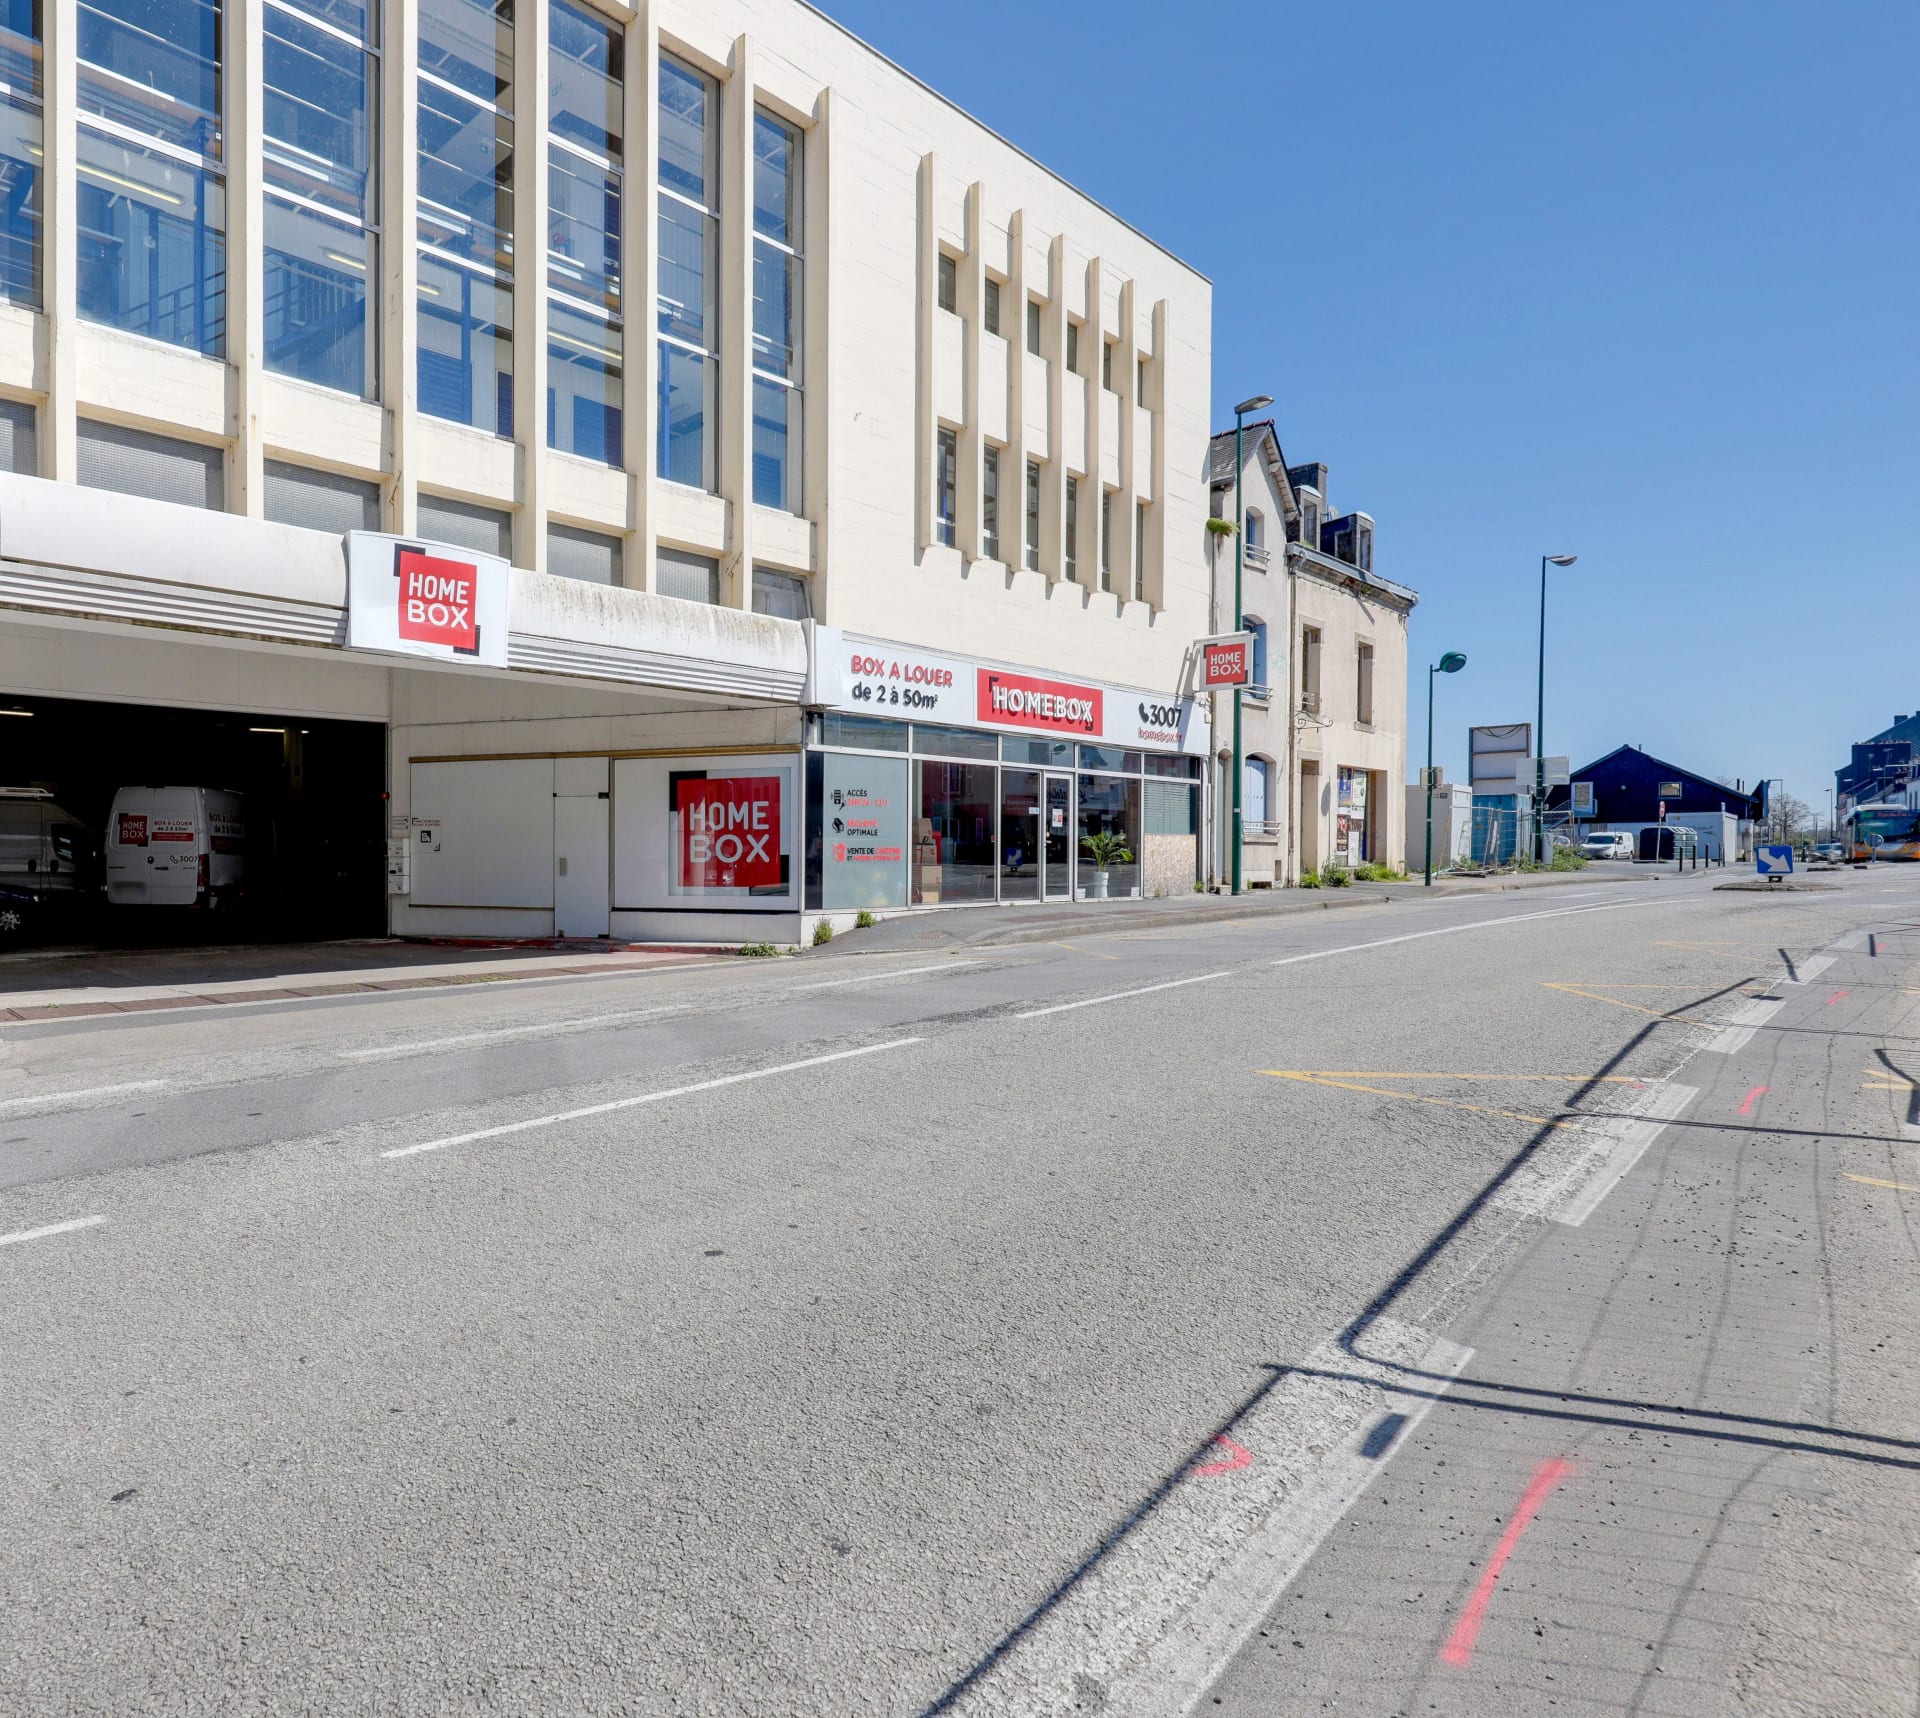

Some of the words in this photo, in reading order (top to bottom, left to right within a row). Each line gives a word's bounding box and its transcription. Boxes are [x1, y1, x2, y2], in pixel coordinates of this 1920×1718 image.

[409, 572, 470, 605] HOME
[407, 599, 469, 630] BOX
[1210, 651, 1242, 665] HOME
[1210, 663, 1241, 677] BOX
[851, 655, 885, 677] BOX
[889, 661, 901, 680] A
[904, 663, 953, 688] LOUER
[852, 681, 872, 701] de
[876, 684, 886, 703] 2
[890, 685, 899, 705] à
[992, 685, 1093, 723] HOMEBOX
[1150, 704, 1182, 728] 3007
[847, 787, 868, 797] ACCÈS
[122, 821, 145, 830] HOME
[689, 800, 770, 832] HOME
[122, 830, 144, 839] BOX
[179, 855, 199, 863] 3007
[689, 834, 770, 863] BOX
[847, 847, 866, 855] VENTE
[867, 847, 875, 855] DE
